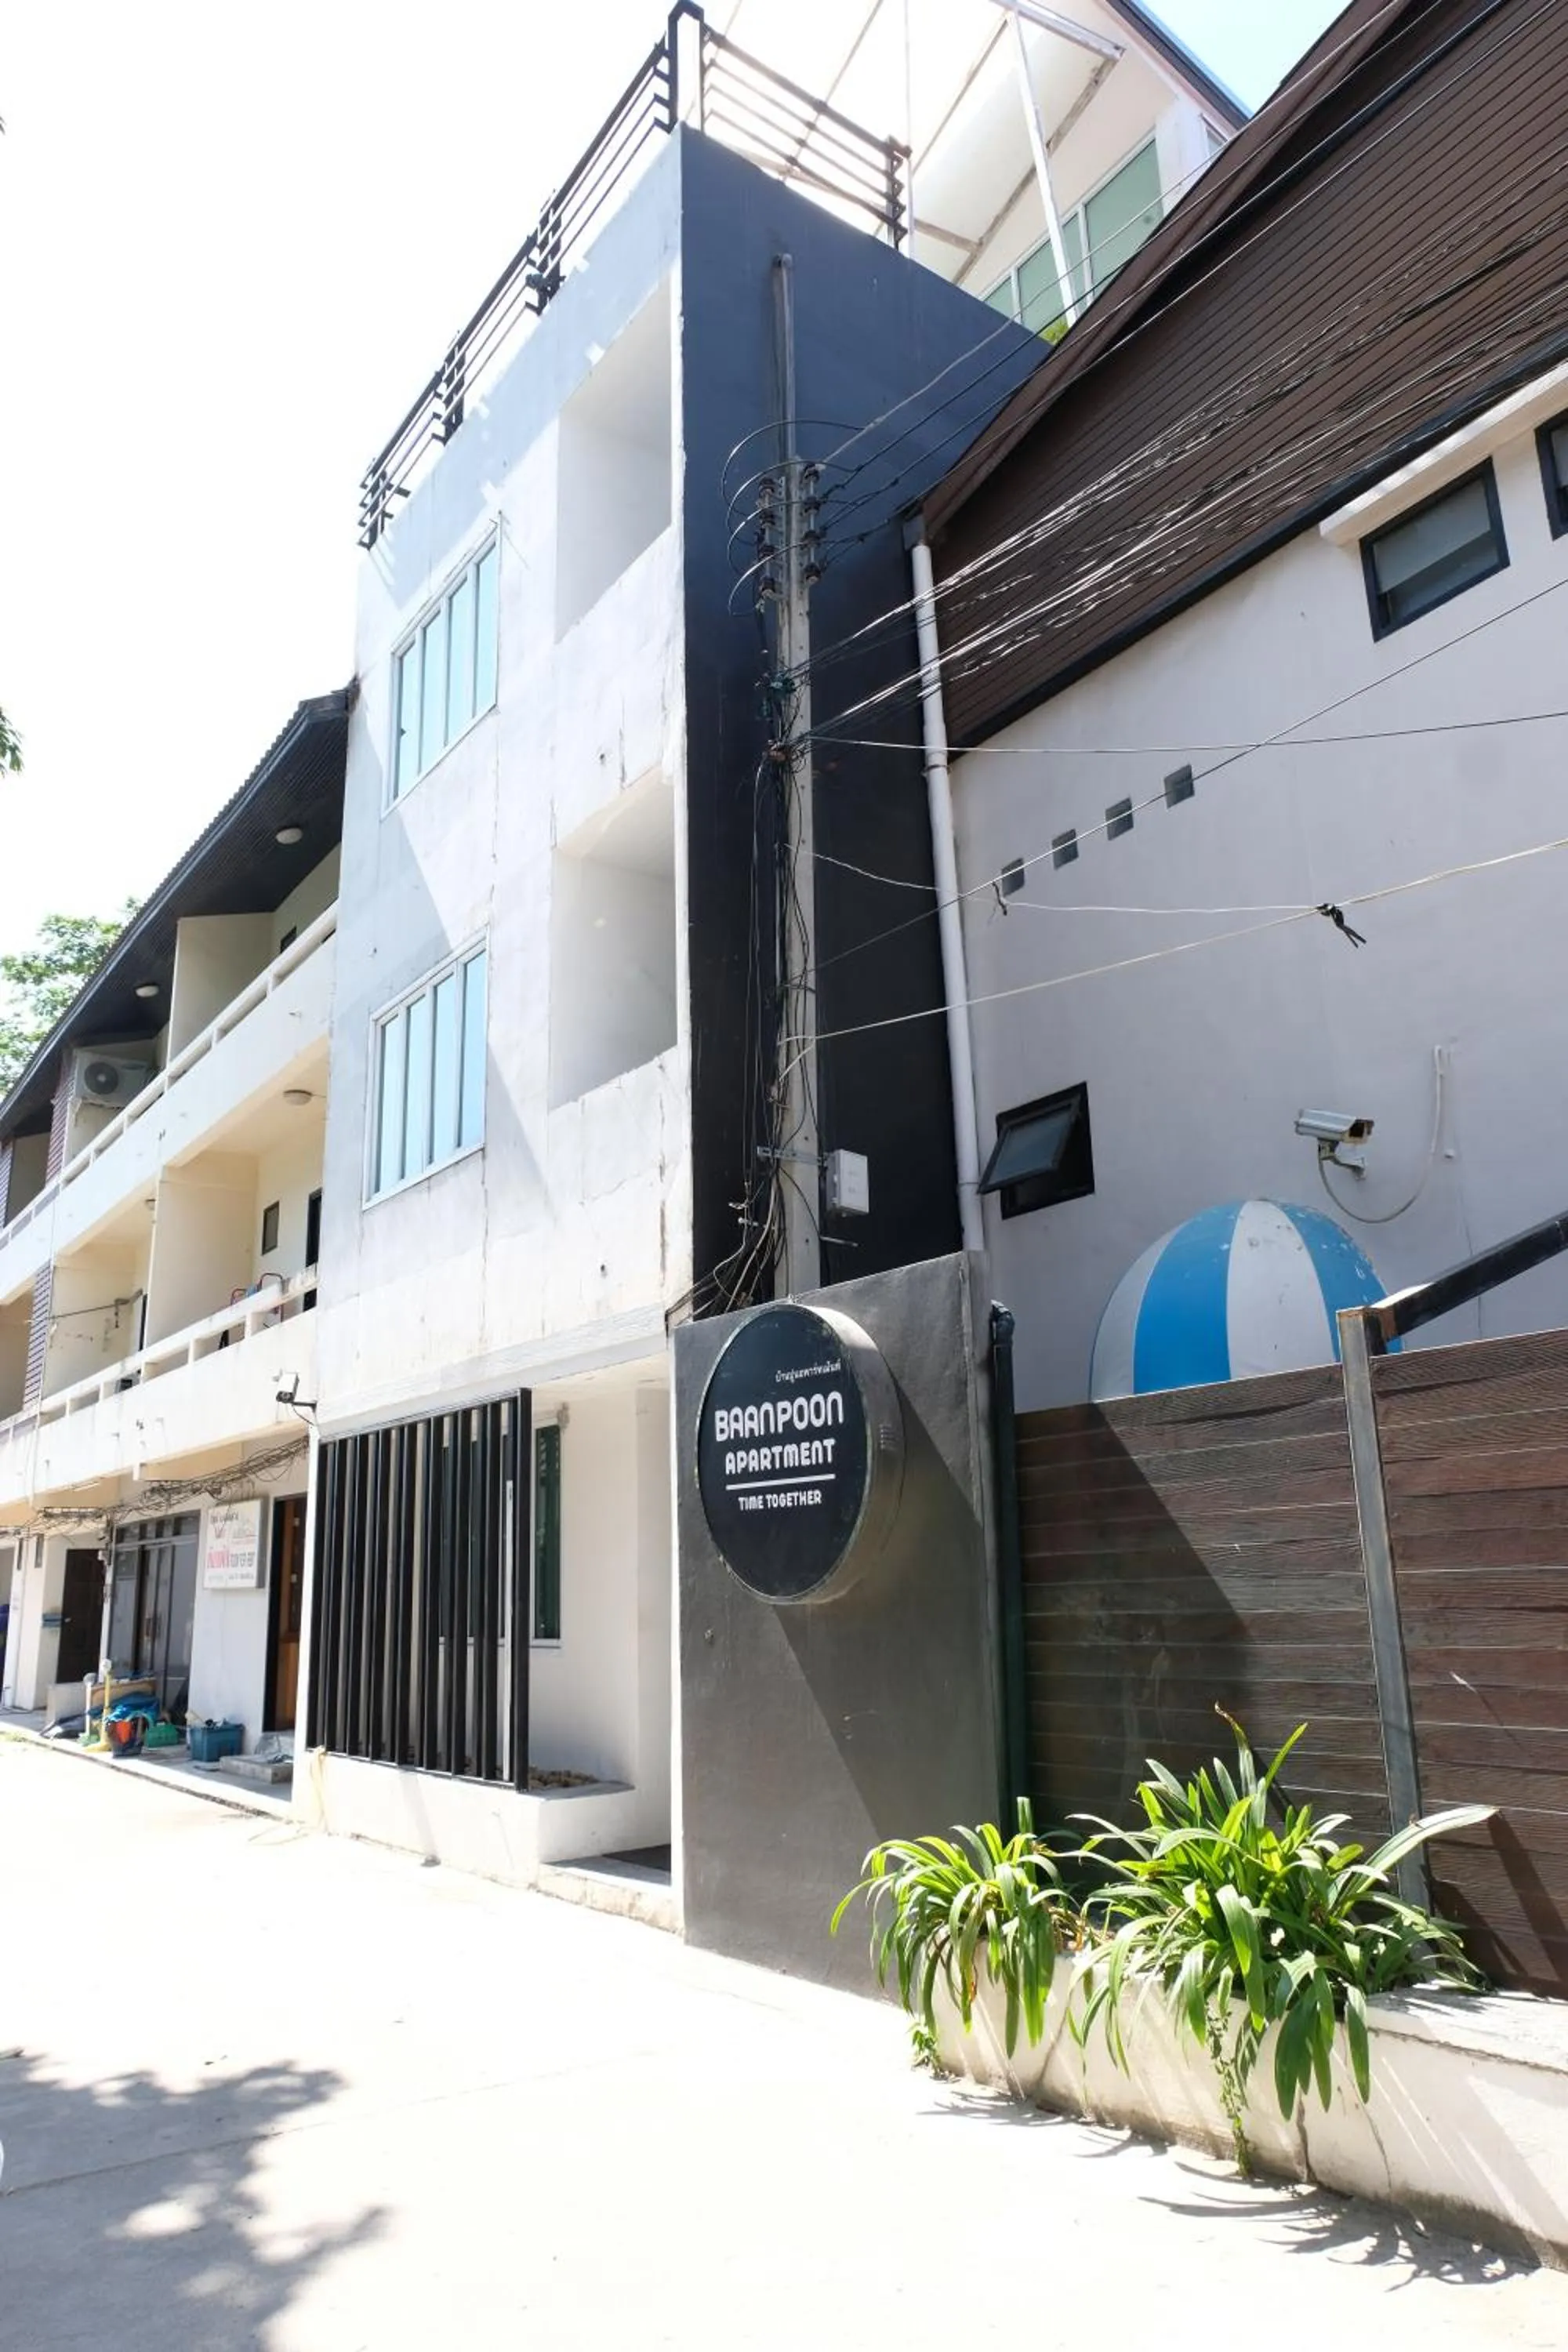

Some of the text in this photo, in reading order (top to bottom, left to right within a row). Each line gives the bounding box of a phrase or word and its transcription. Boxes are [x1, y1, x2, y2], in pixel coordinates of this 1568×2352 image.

[714, 1391, 844, 1442] BAANPOON
[725, 1438, 836, 1475] APARTMENT
[738, 1490, 822, 1511] TIME TOGETHER
